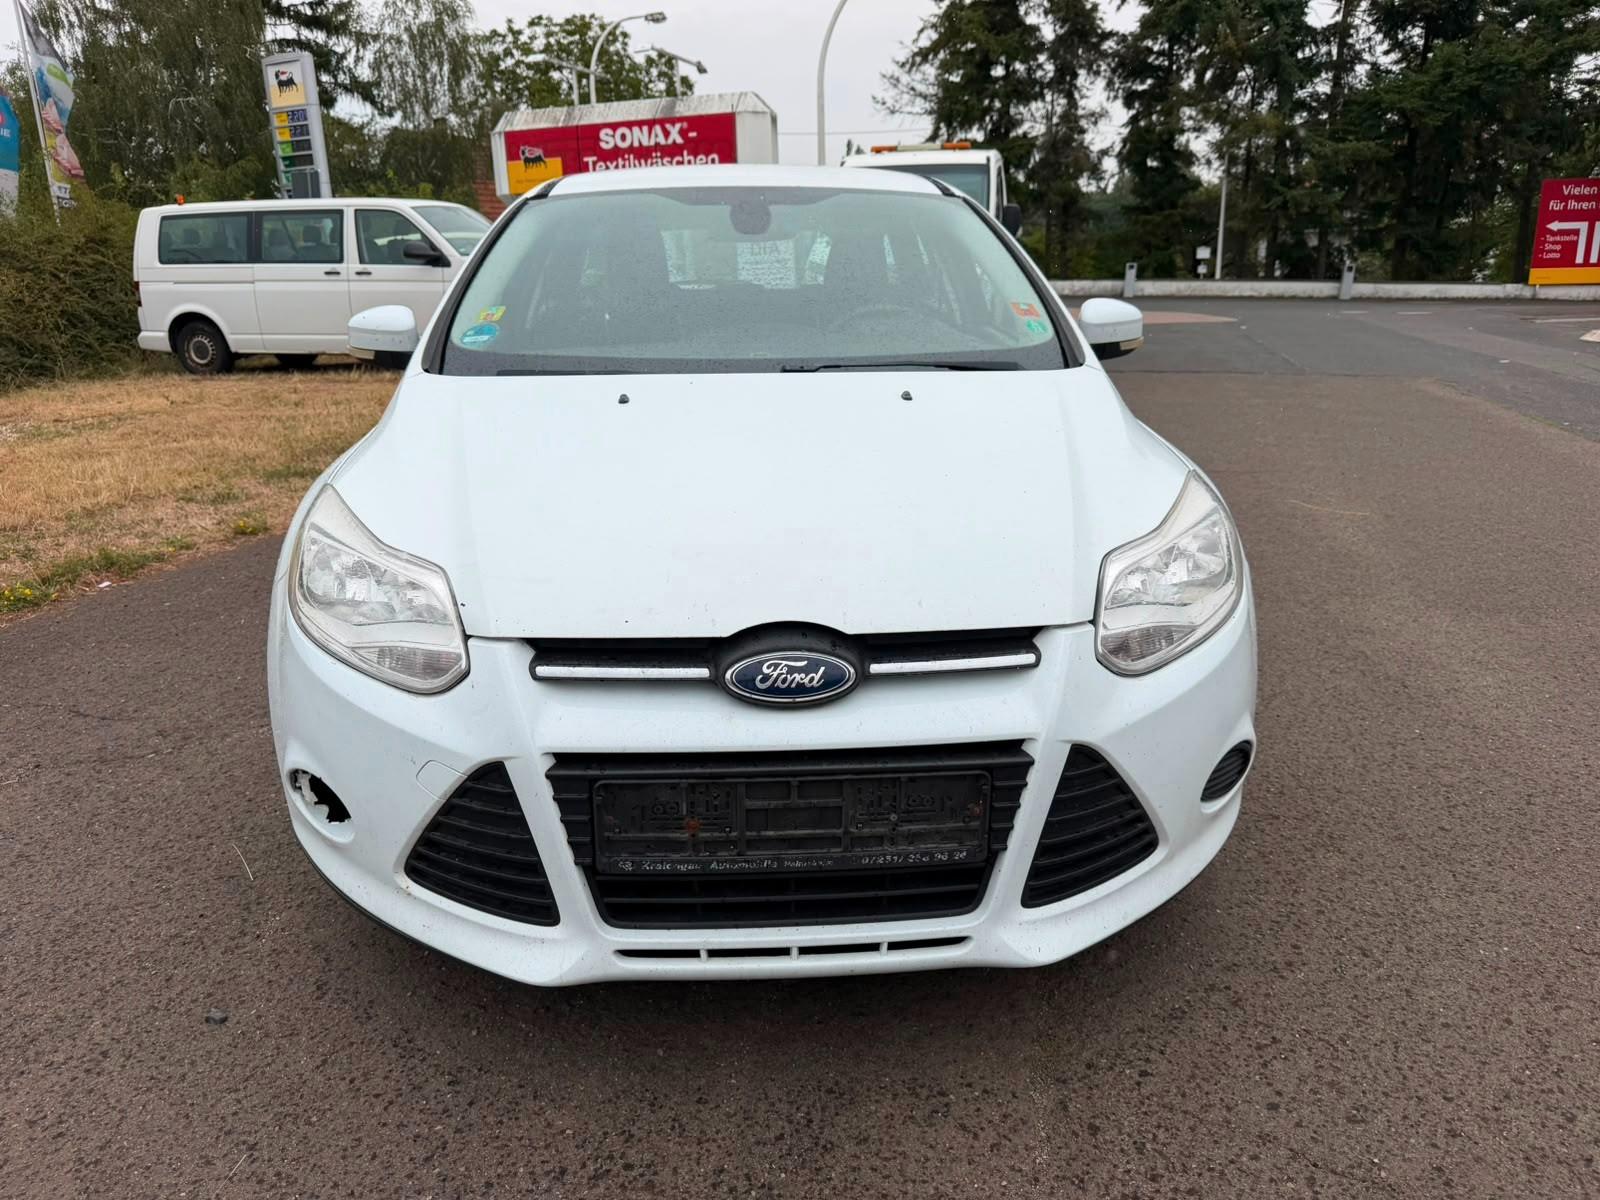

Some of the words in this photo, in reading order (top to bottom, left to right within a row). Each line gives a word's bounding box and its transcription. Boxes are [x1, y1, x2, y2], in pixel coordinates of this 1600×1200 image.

[583, 149, 719, 173] Textilwäschen
[1562, 185, 1598, 195] Vielen
[1549, 200, 1565, 211] für
[1567, 200, 1596, 210] Ihren
[1544, 243, 1562, 251] Shop
[755, 660, 826, 690] Ford
